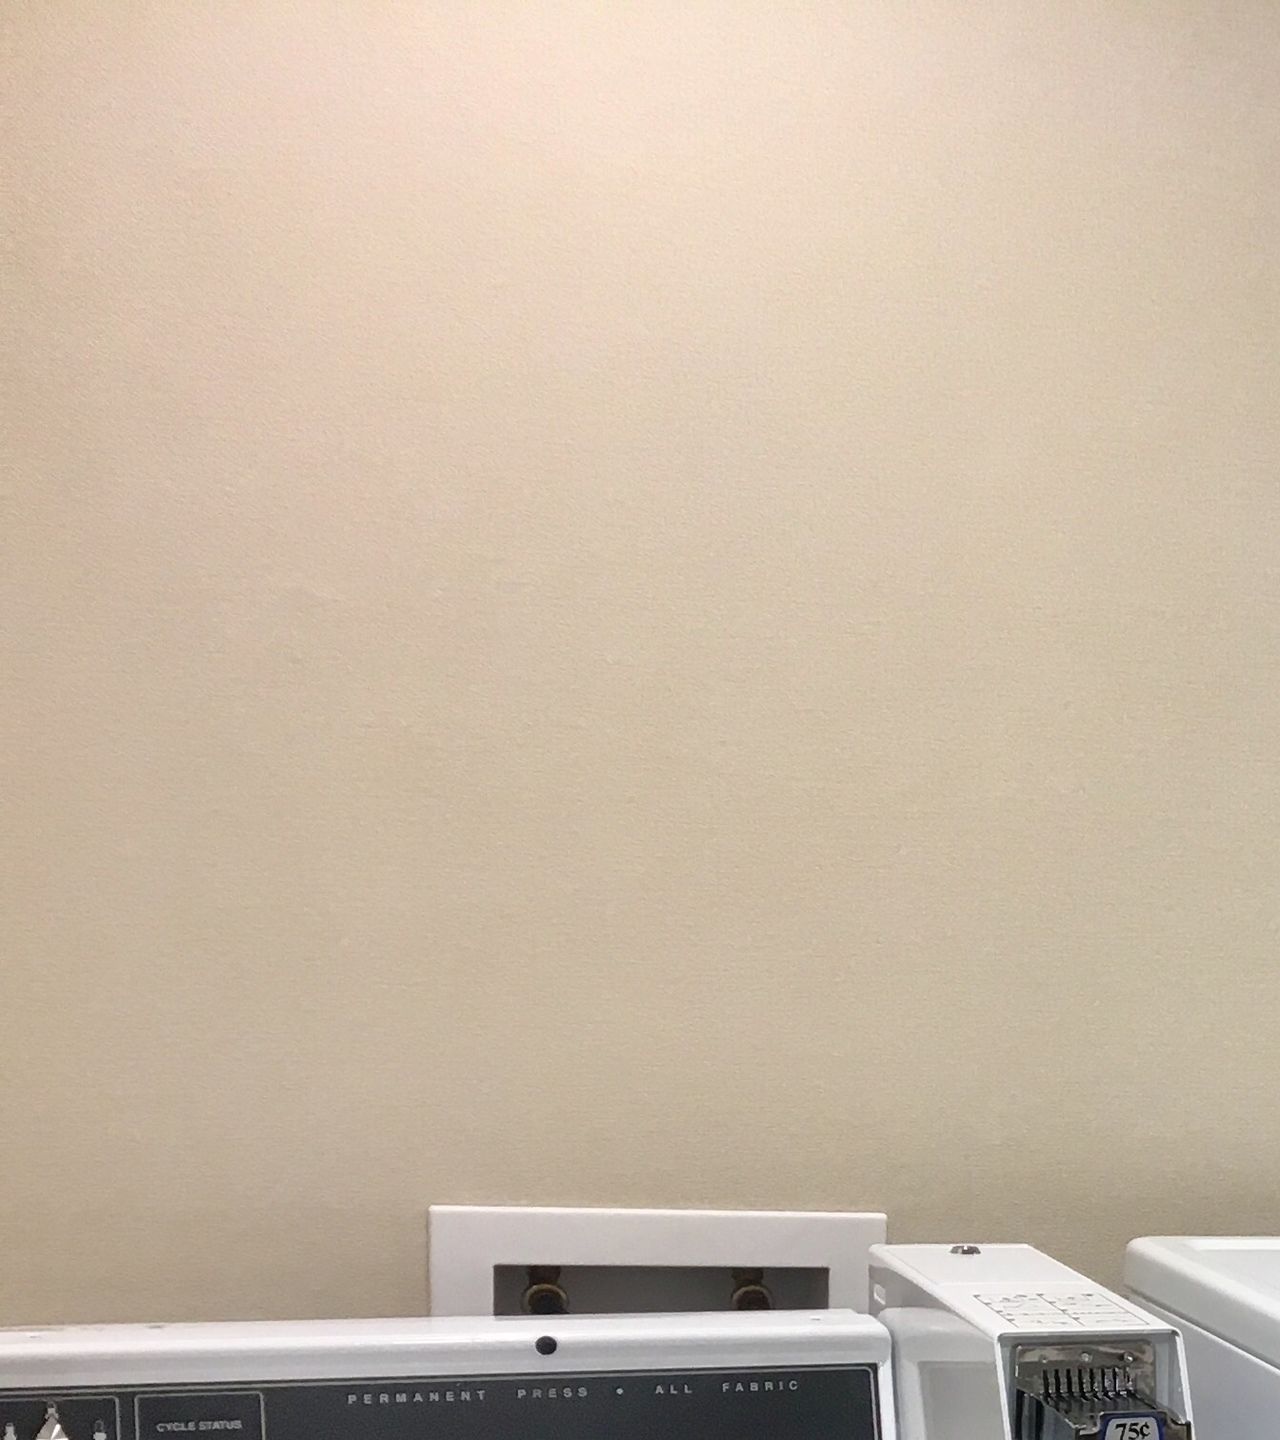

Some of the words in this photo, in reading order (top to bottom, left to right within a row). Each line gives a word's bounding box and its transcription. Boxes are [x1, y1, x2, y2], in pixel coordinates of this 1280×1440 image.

[348, 1390, 486, 1404] PERMANENT
[518, 1387, 589, 1399] PRESS
[655, 1384, 693, 1395] ALL
[722, 1381, 798, 1392] FABRIC
[156, 1422, 195, 1432] CYCLE
[198, 1420, 242, 1430] STATUS
[1114, 1423, 1150, 1440] 75¢
